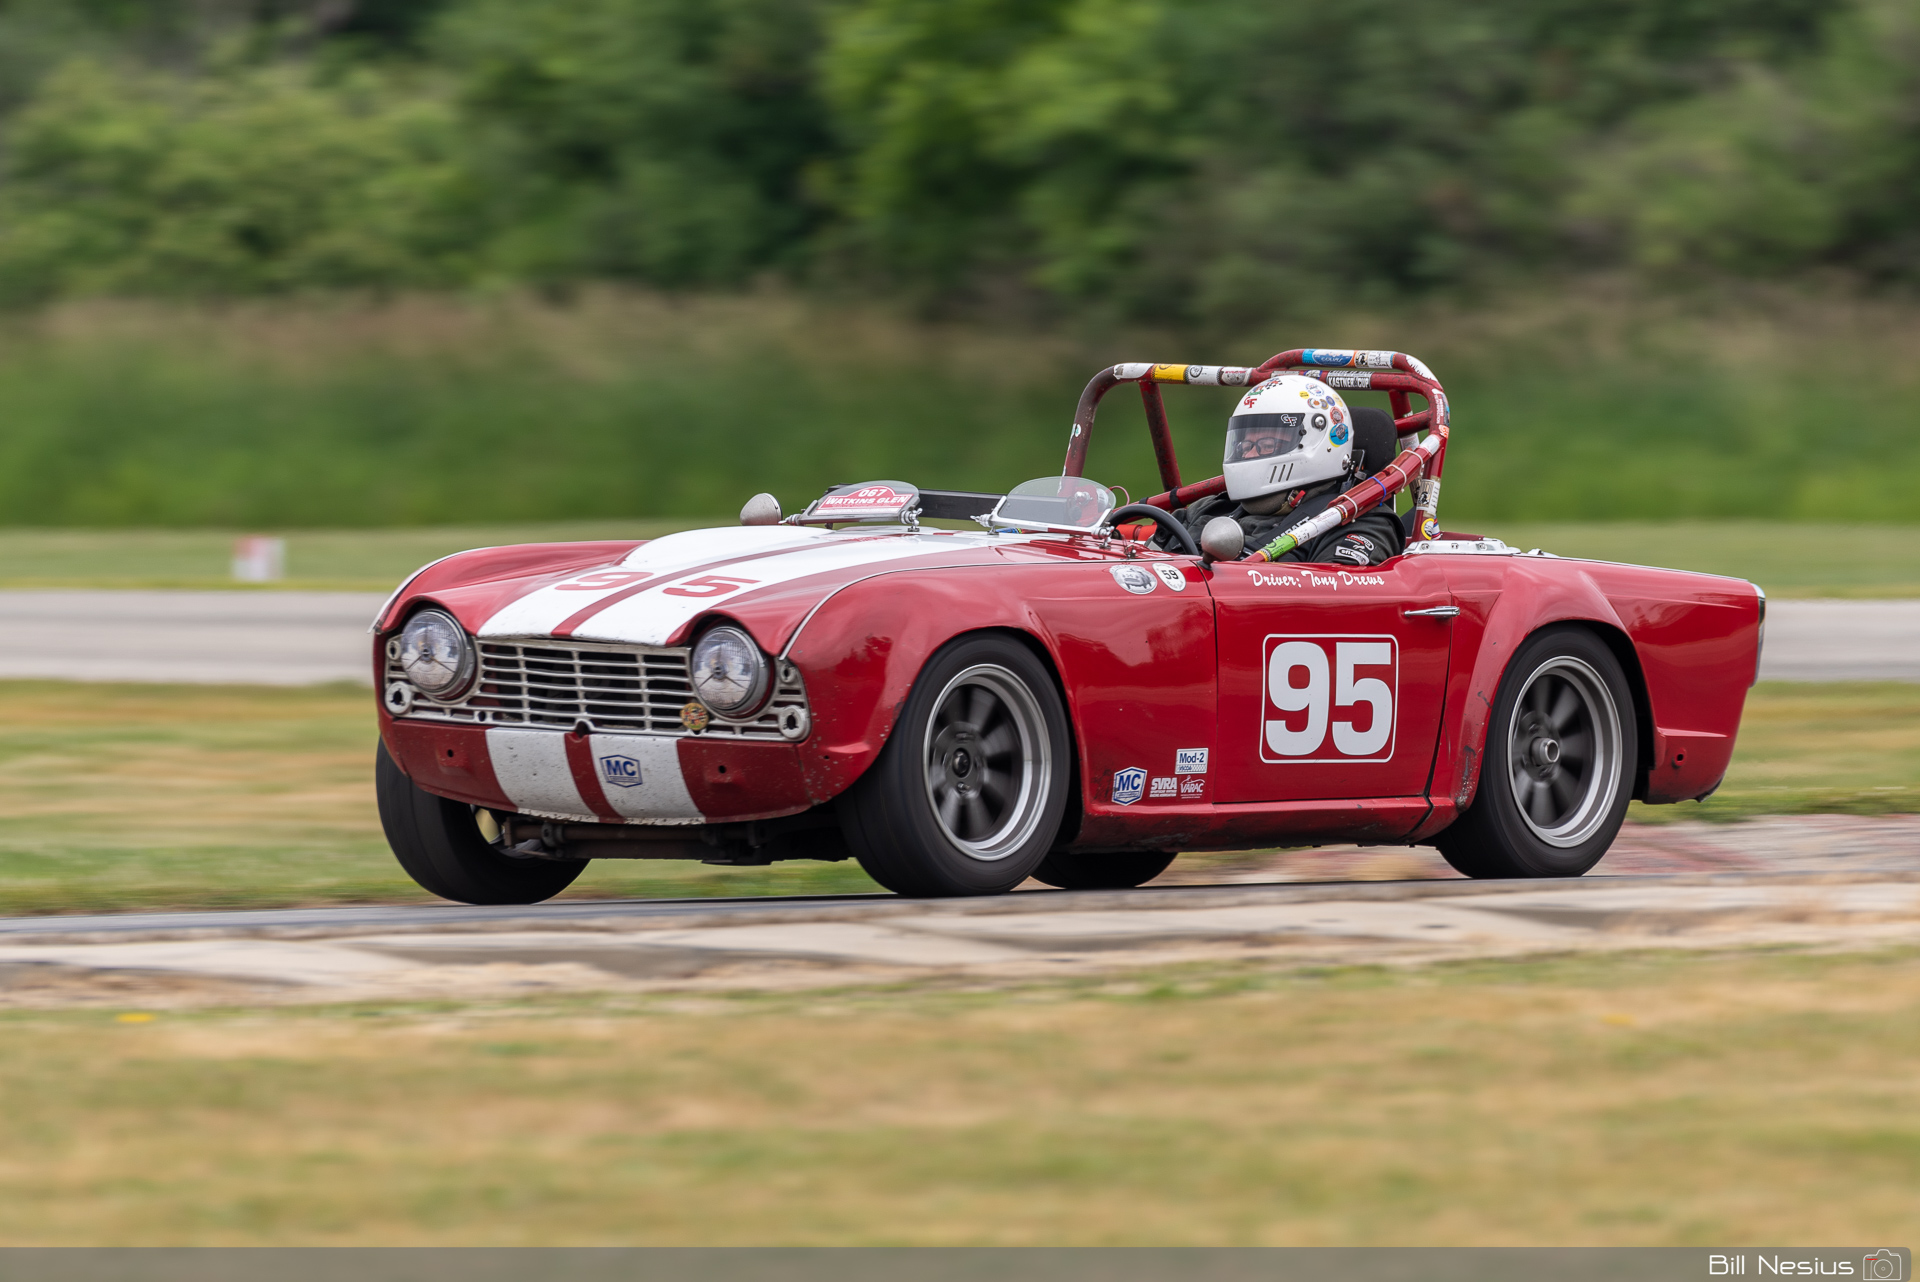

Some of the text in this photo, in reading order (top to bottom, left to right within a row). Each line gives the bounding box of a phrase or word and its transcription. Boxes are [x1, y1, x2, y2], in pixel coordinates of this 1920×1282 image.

[1328, 376, 1370, 388] KASTNER CUP
[857, 488, 888, 498] 067
[825, 495, 909, 505] WATKINS GLEN
[1161, 569, 1179, 580] 59
[1301, 570, 1337, 591] Tony
[1337, 570, 1385, 586] Drews
[554, 571, 763, 598] 95
[1265, 641, 1393, 756] 95
[1179, 752, 1205, 763] Mod-2
[606, 759, 637, 777] MC
[1118, 773, 1142, 791] MC
[1150, 777, 1178, 790] SVRA
[1180, 783, 1205, 794] VARAC
